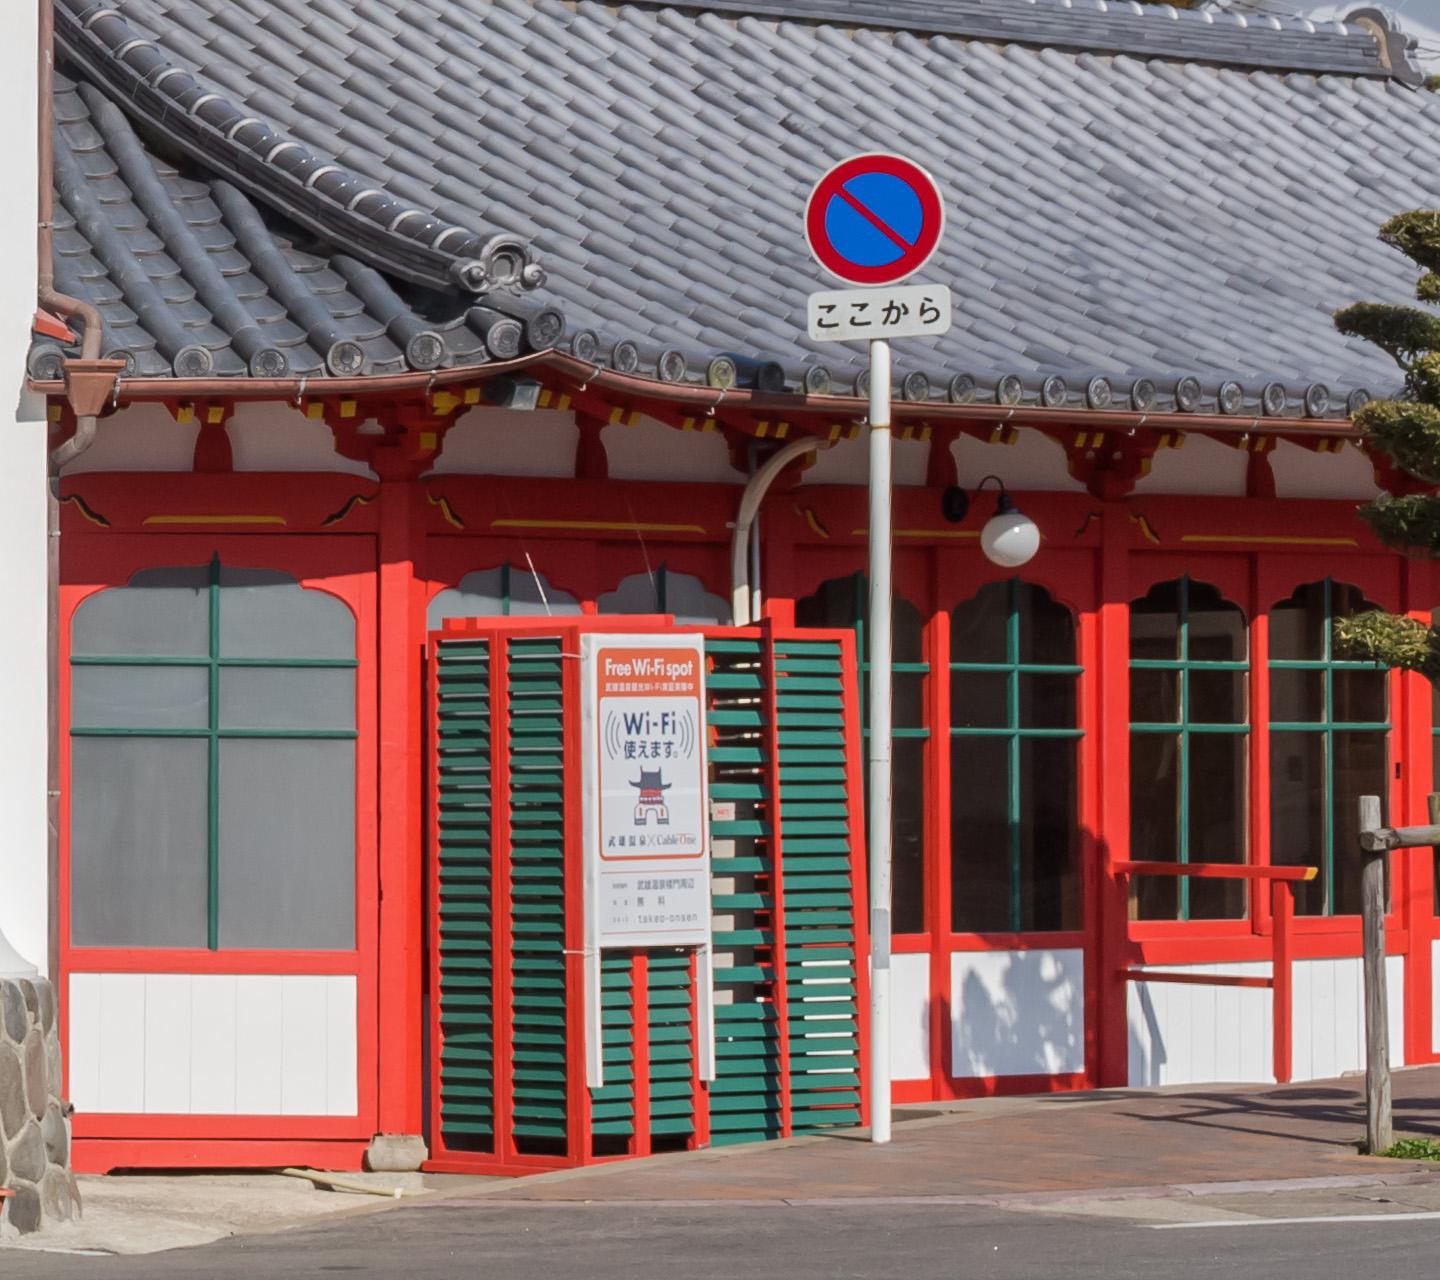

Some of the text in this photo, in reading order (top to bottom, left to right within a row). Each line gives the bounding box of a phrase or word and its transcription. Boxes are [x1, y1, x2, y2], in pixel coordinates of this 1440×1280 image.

[816, 296, 941, 329] ここから
[606, 659, 692, 680] Free Wi-Fi spot
[624, 711, 675, 735] Wi-Fi
[624, 741, 678, 759] 使えます。
